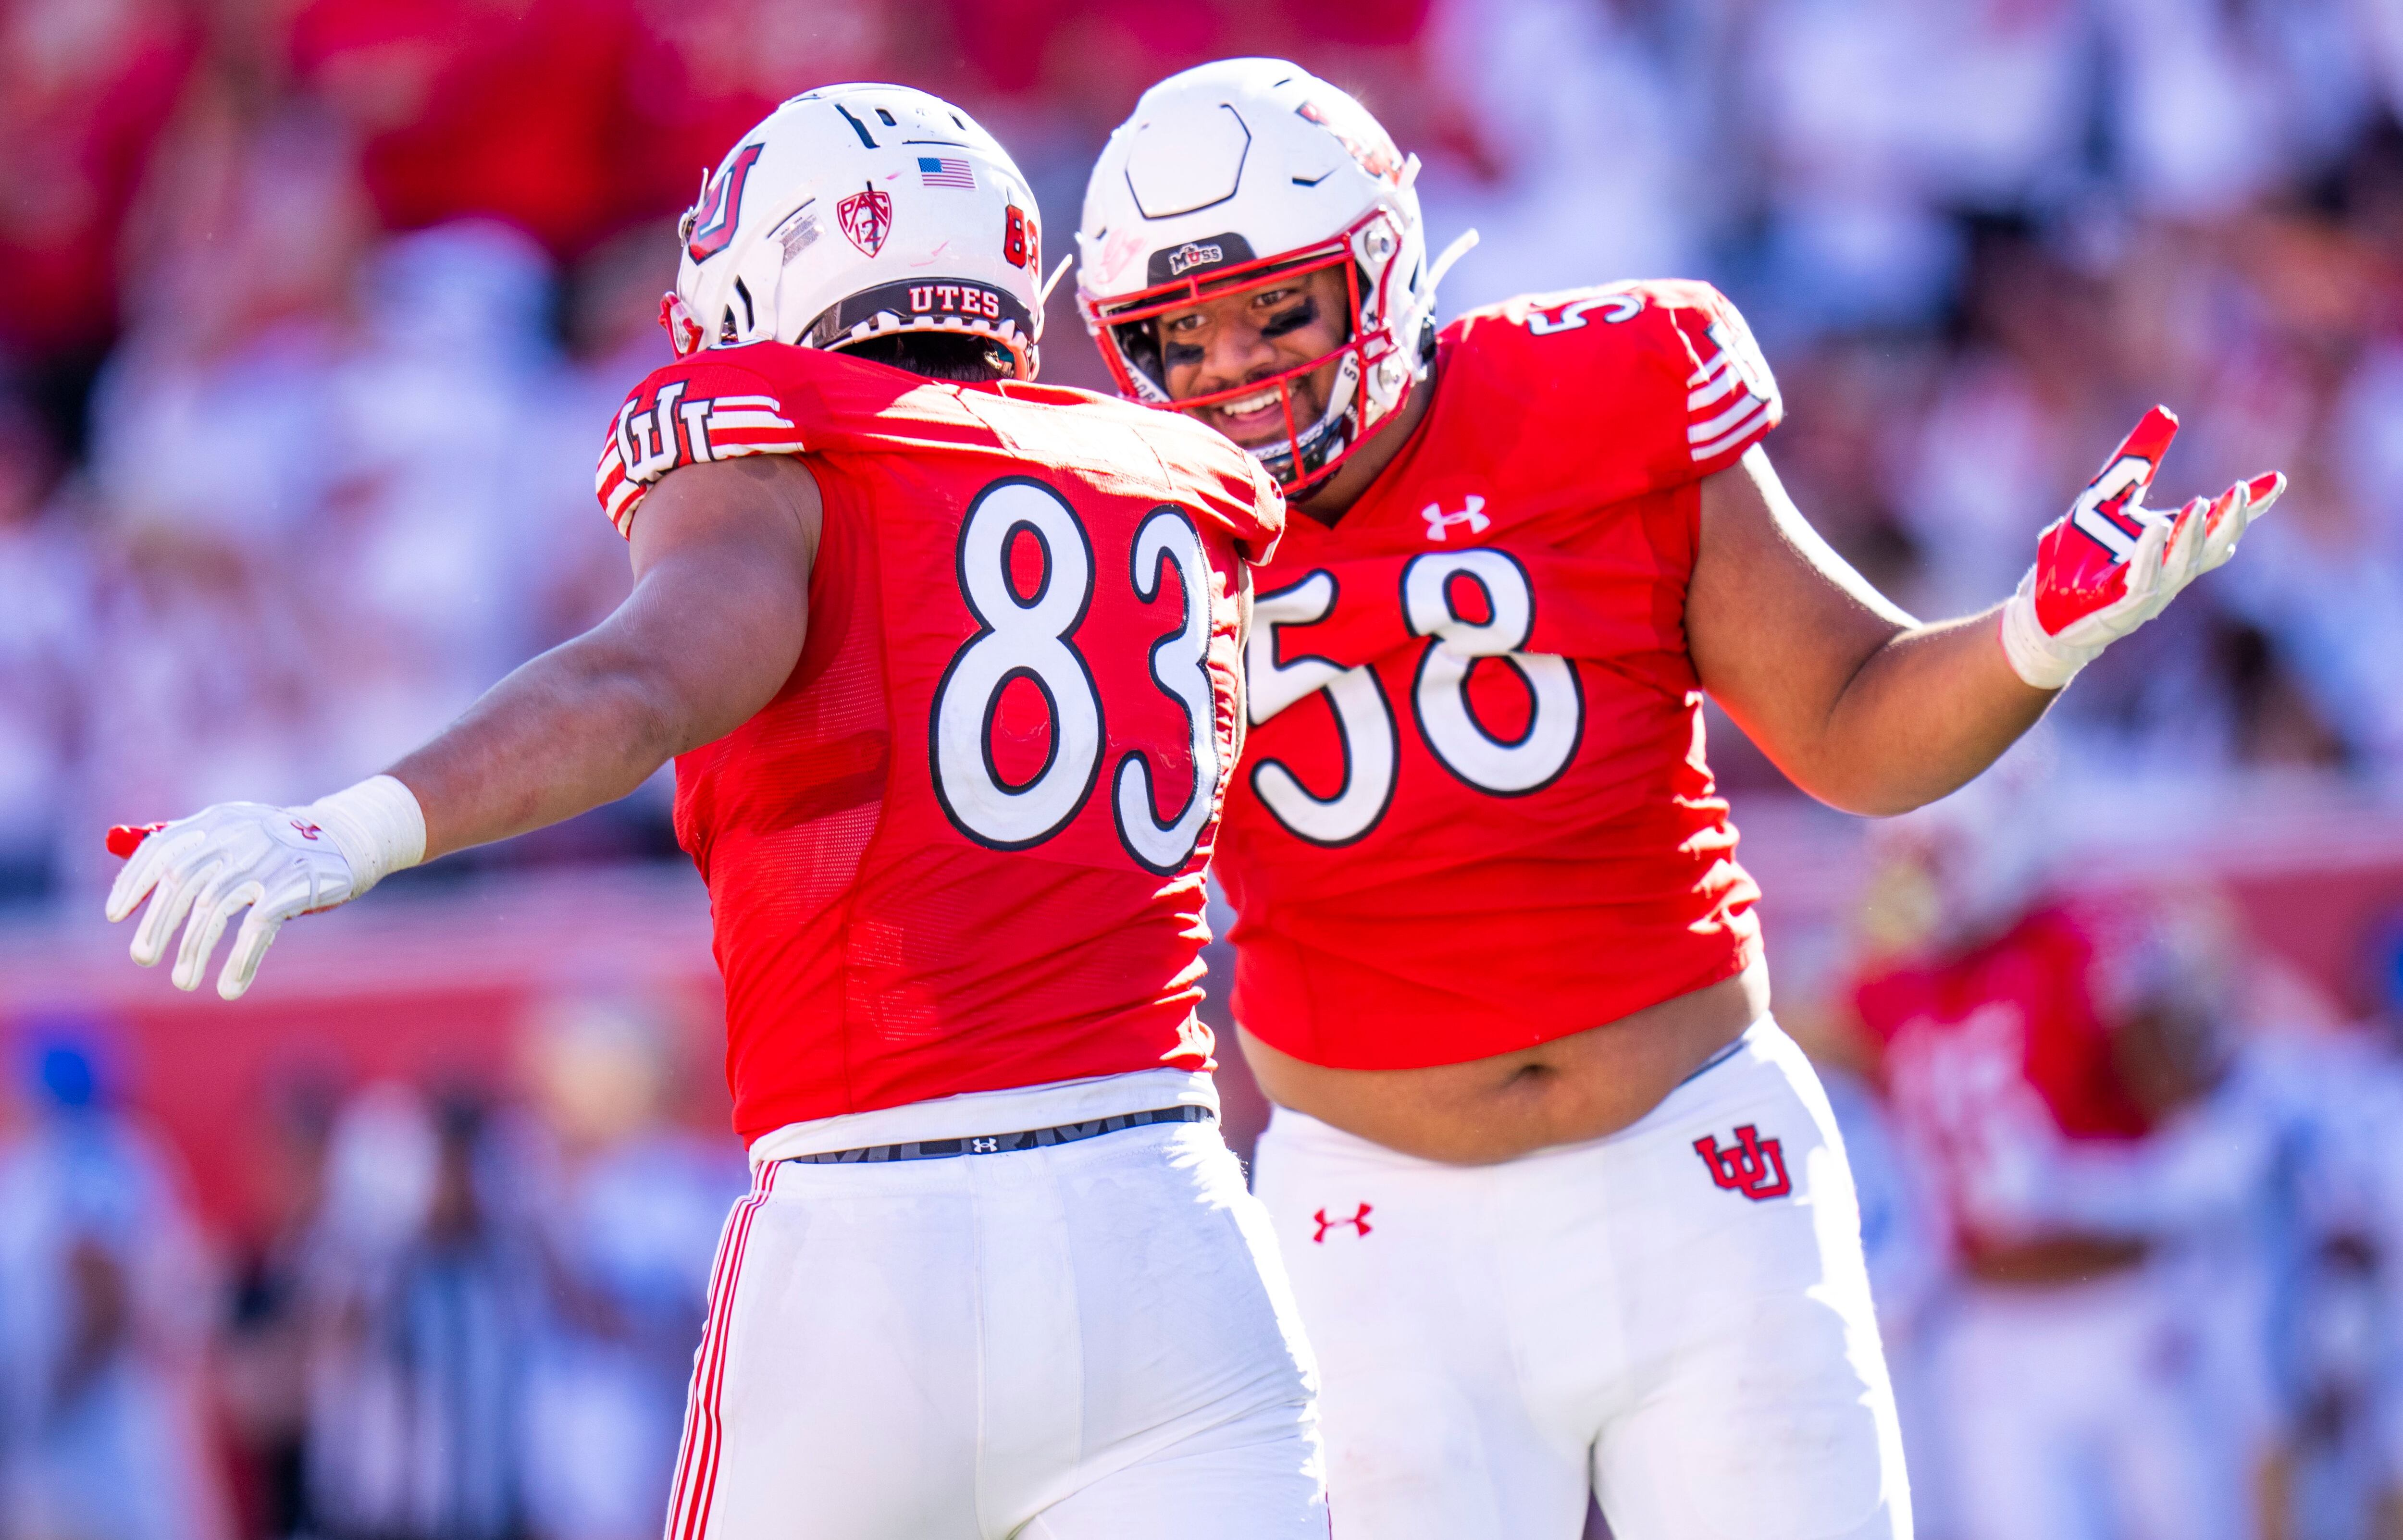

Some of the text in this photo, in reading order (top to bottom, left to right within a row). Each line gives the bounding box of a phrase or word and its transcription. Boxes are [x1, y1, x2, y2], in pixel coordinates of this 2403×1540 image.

[841, 194, 889, 233] PAC
[855, 219, 882, 244] 12
[1003, 204, 1039, 277] 83
[909, 285, 999, 319] UTES
[928, 475, 1221, 876] 83
[1244, 547, 1585, 848] 58
